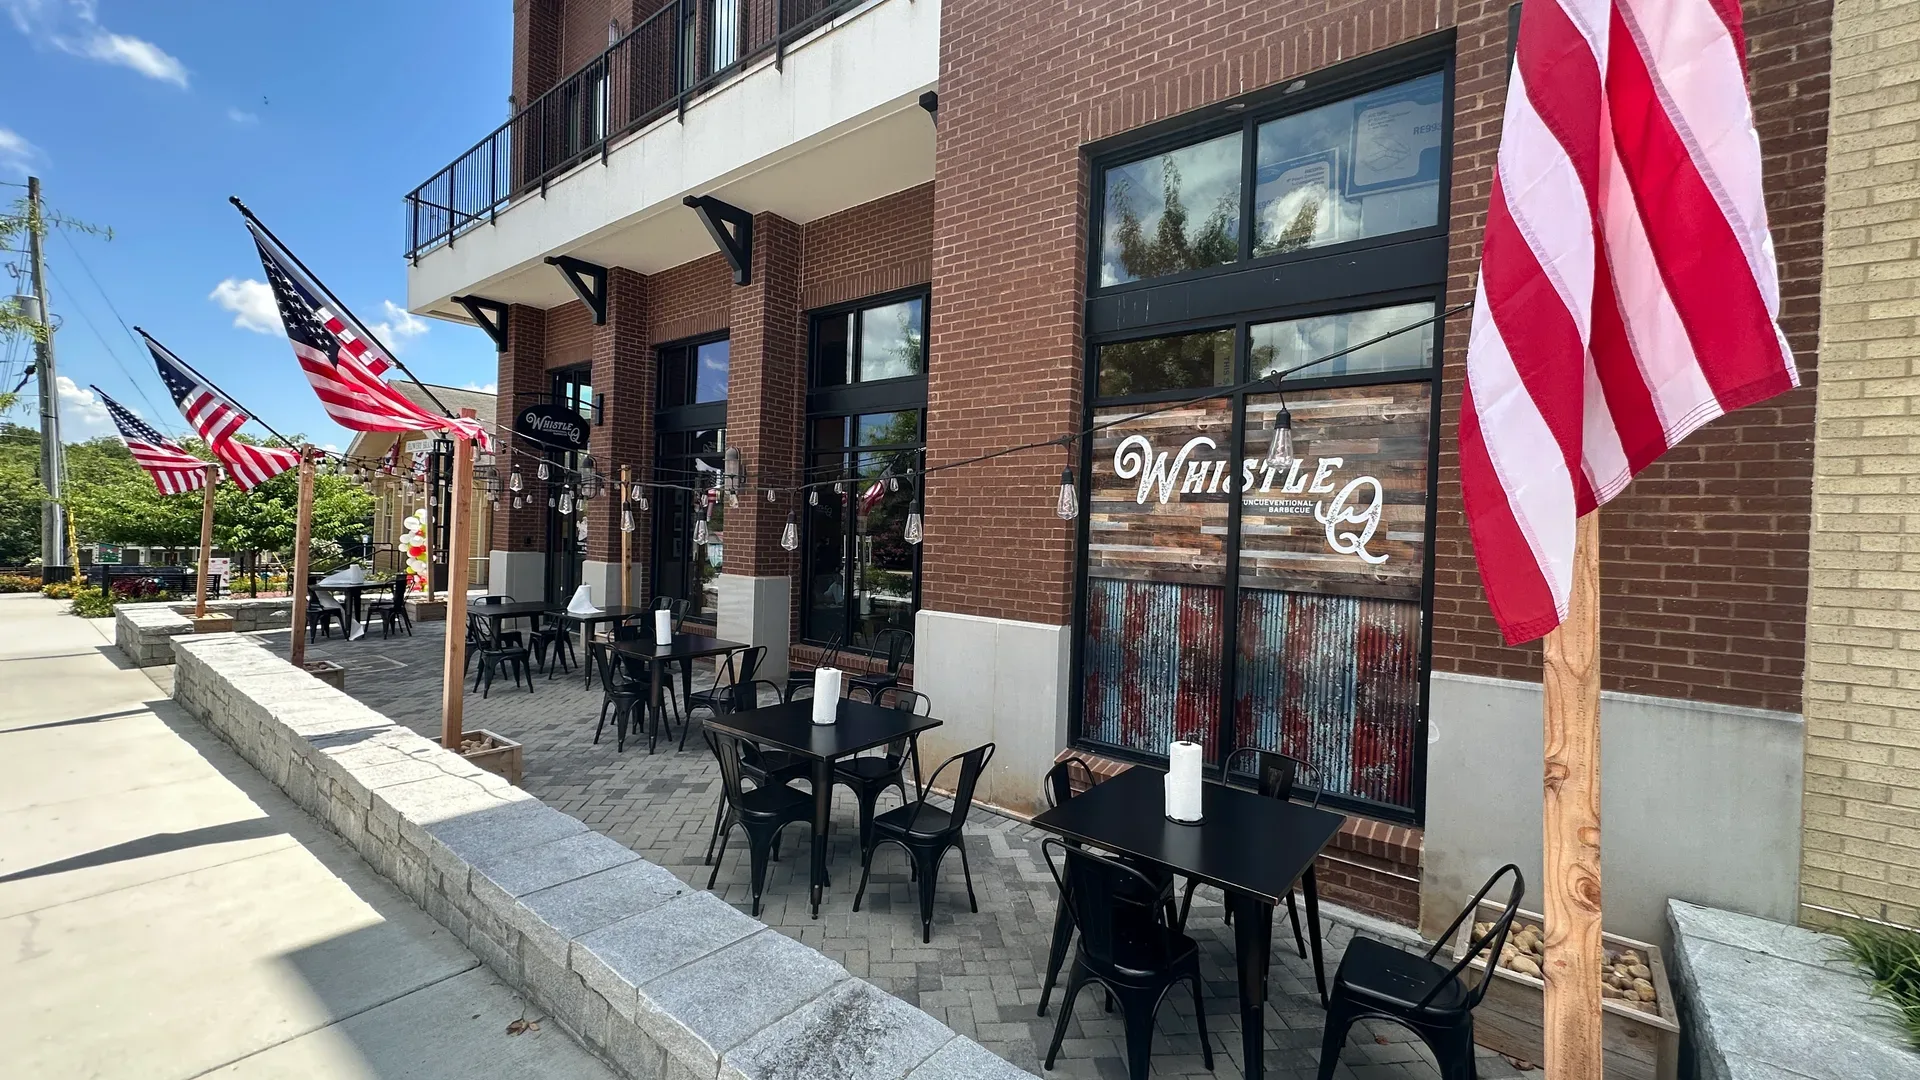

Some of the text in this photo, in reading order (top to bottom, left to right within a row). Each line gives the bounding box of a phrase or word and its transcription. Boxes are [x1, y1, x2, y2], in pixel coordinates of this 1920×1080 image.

[526, 412, 574, 430] WHISTLE
[567, 427, 581, 444] Q
[1113, 434, 1344, 505] WHISTLE
[1243, 498, 1314, 507] UNCUEVENTIONAL
[1268, 506, 1311, 514] BARBECUE
[1314, 475, 1390, 564] Q
